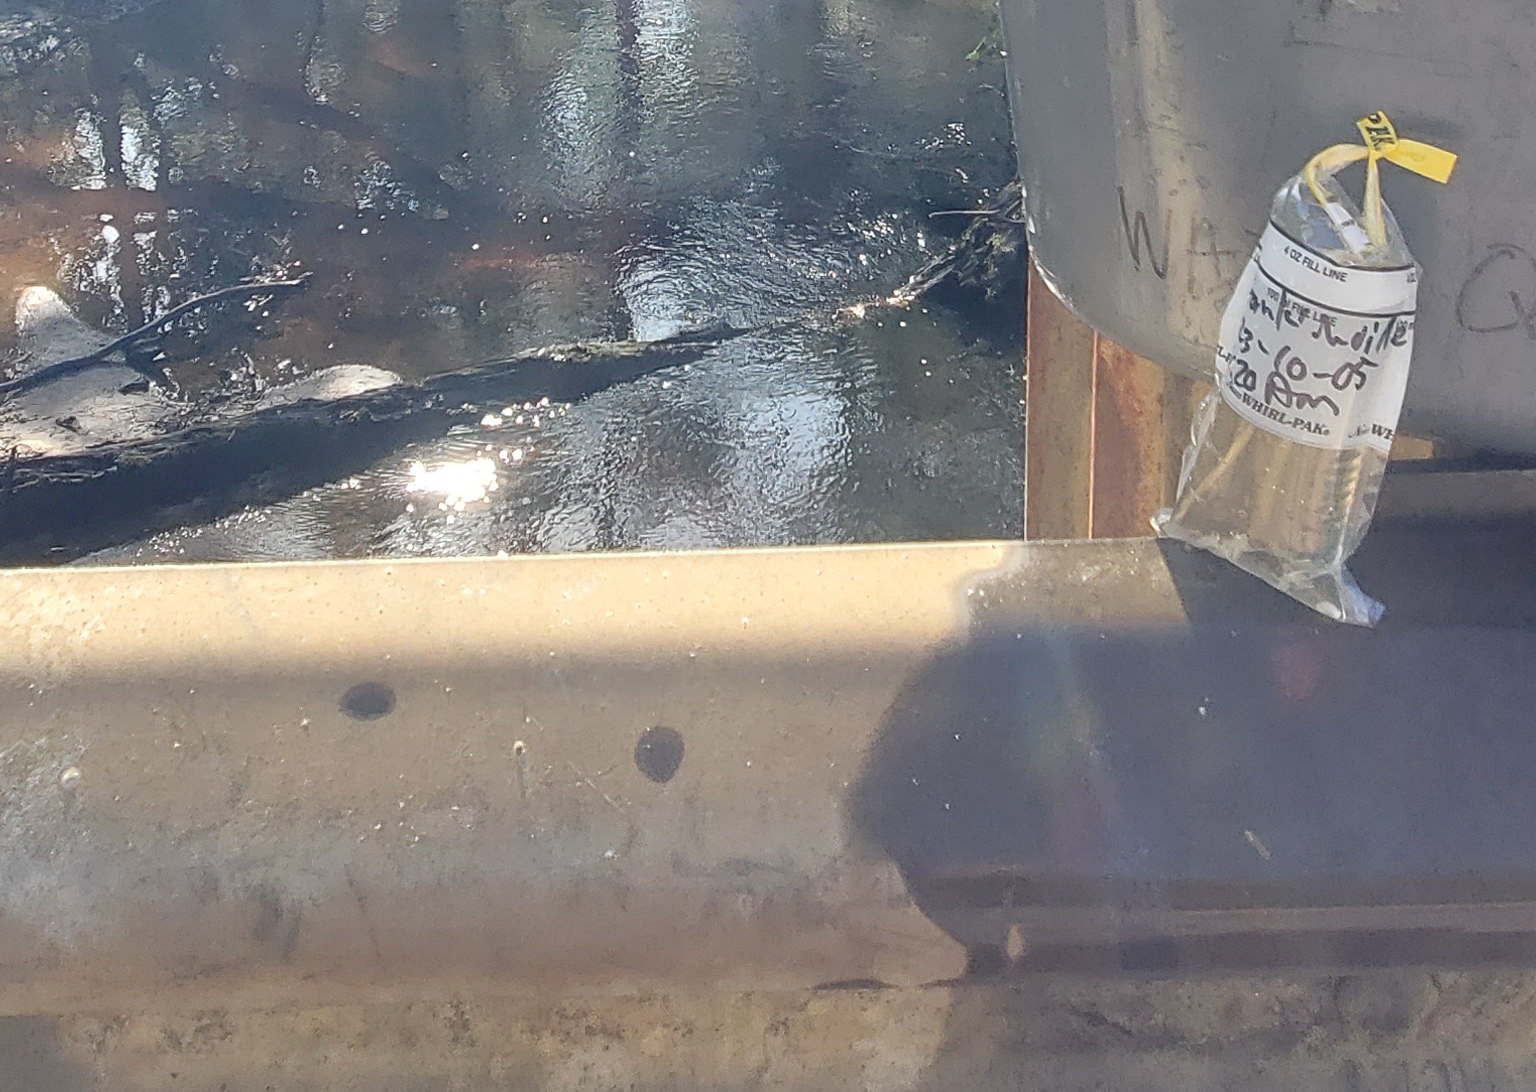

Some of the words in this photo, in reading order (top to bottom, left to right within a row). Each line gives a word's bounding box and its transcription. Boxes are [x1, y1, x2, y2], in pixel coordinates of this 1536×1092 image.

[1284, 246, 1290, 255] 4
[1289, 249, 1303, 262] OZ
[1302, 257, 1322, 274] FILL
[1322, 267, 1348, 283] LINE
